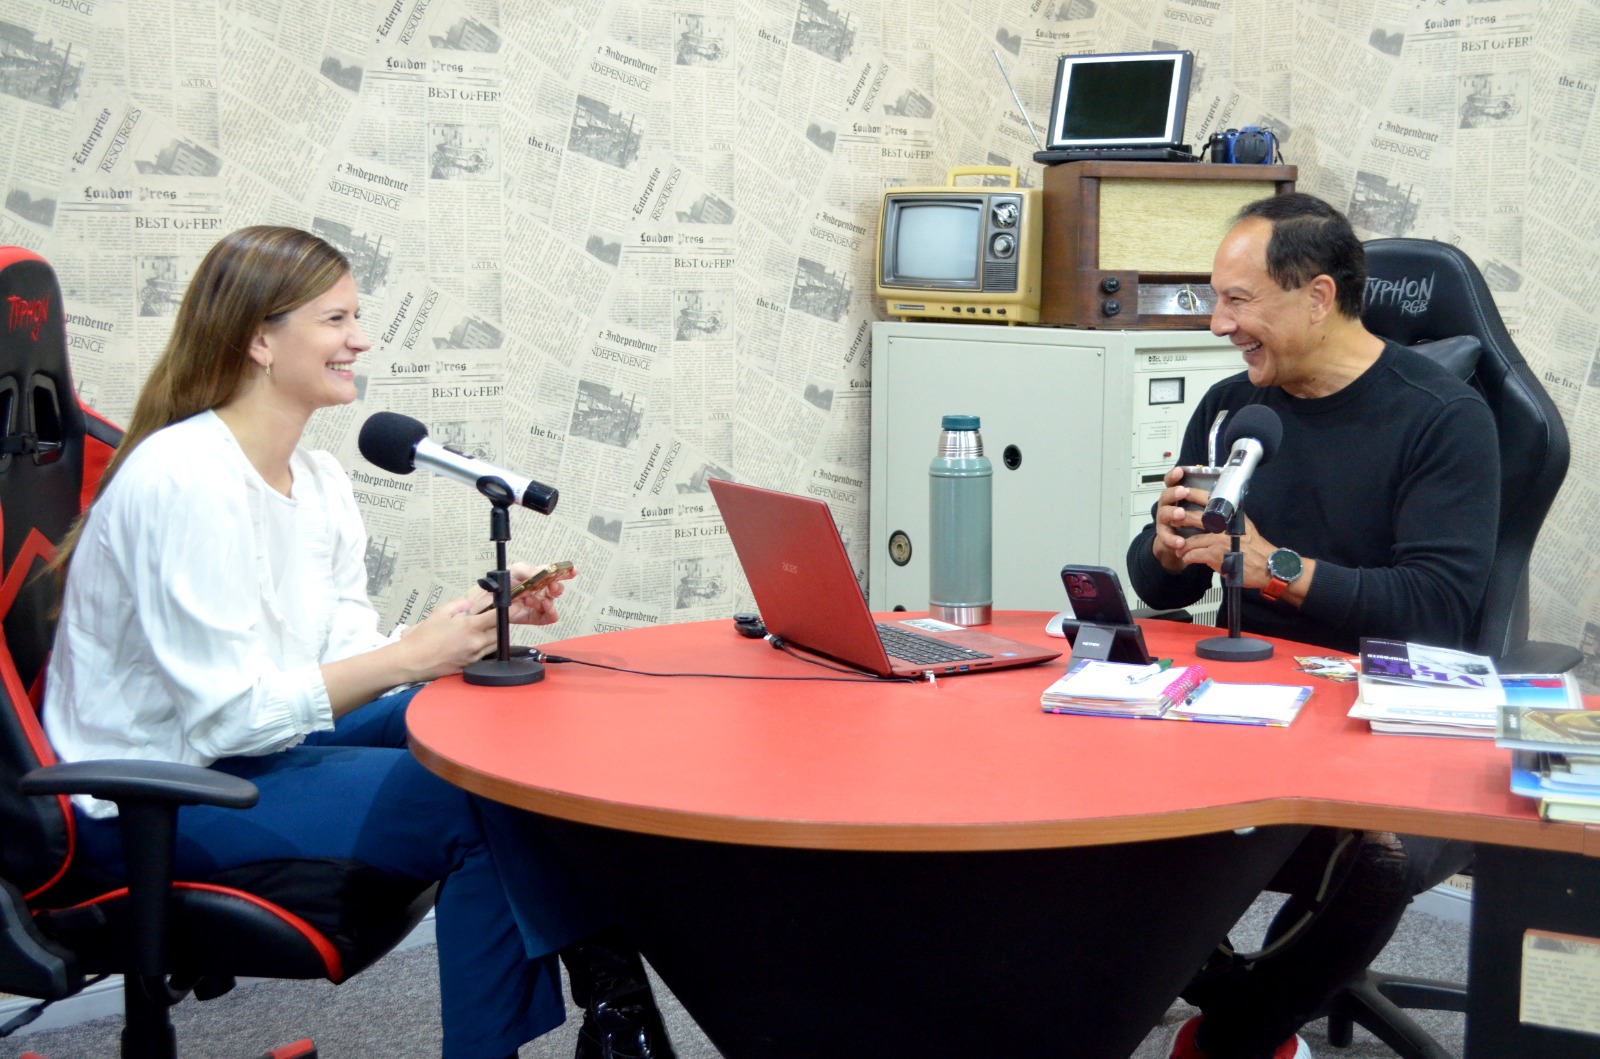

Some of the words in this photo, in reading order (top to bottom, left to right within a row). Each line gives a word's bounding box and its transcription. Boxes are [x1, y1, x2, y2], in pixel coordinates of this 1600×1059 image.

[376, 0, 404, 38] Enterpr
[400, 0, 431, 46] RESOURC
[1424, 17, 1461, 32] London
[758, 28, 772, 41] the
[1461, 40, 1490, 51] BEST
[386, 56, 427, 71] London
[605, 46, 658, 75] Independence
[1558, 75, 1575, 88] the
[428, 87, 457, 100] BEST
[1385, 120, 1439, 142] Independence
[100, 107, 142, 174] RESOURCES
[528, 136, 543, 149] the
[881, 147, 902, 158] BEST
[345, 163, 409, 192] Independence
[84, 186, 133, 202] London
[652, 167, 682, 222] RESOURCES
[135, 217, 170, 229] BEST
[640, 231, 674, 245] London
[674, 257, 699, 268] BEST
[1361, 271, 1435, 306] TYPHON
[756, 297, 770, 310] the
[1401, 300, 1429, 316] RGB
[65, 312, 114, 333] pendence
[404, 289, 439, 351] RESOURCES
[605, 329, 658, 353] Independence
[390, 362, 431, 377] London
[1544, 371, 1560, 385] the
[432, 387, 461, 398] BEST
[530, 425, 545, 437] the
[652, 441, 682, 496] RESOURCES
[351, 469, 414, 492] Independence
[353, 491, 405, 511] PENDENCE
[640, 506, 674, 520] London
[674, 527, 699, 539] BEST
[607, 605, 659, 624] Independence
